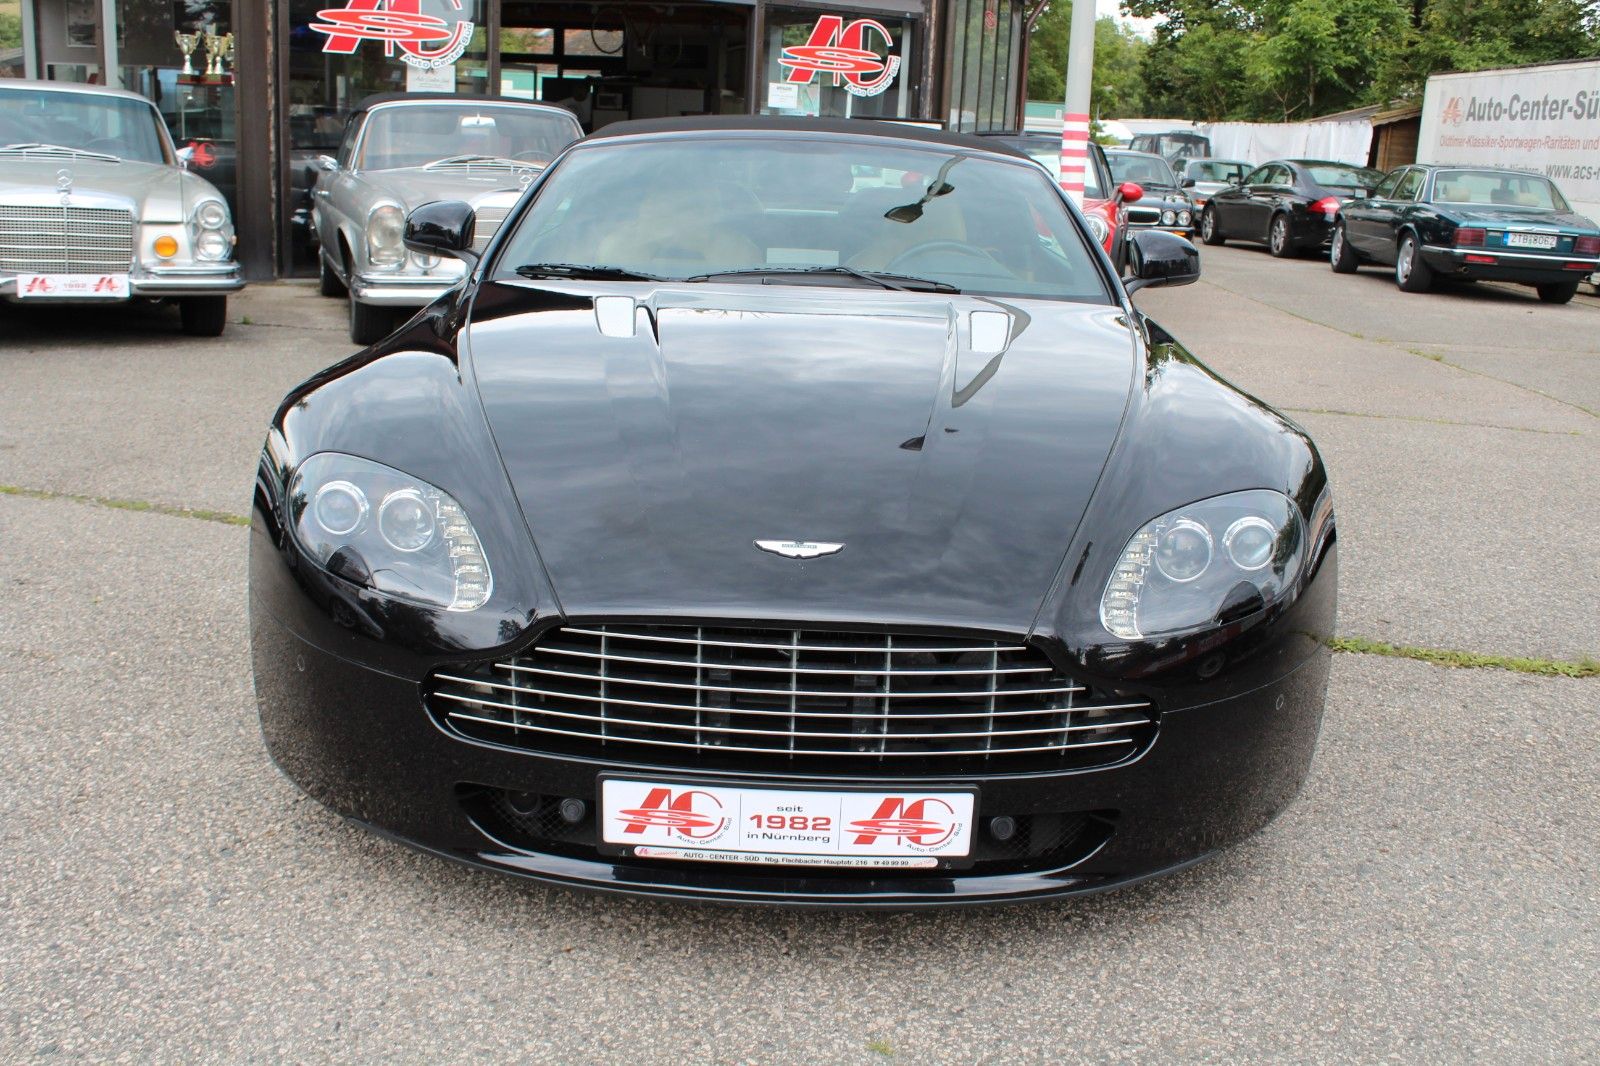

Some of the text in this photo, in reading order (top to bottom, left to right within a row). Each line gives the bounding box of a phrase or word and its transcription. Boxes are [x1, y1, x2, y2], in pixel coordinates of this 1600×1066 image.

[1465, 90, 1600, 121] Auto-Center-Sü
[777, 805, 803, 813] seit
[749, 814, 831, 831] 1982
[762, 832, 830, 844] Nürnberg
[709, 853, 739, 861] CENTER
